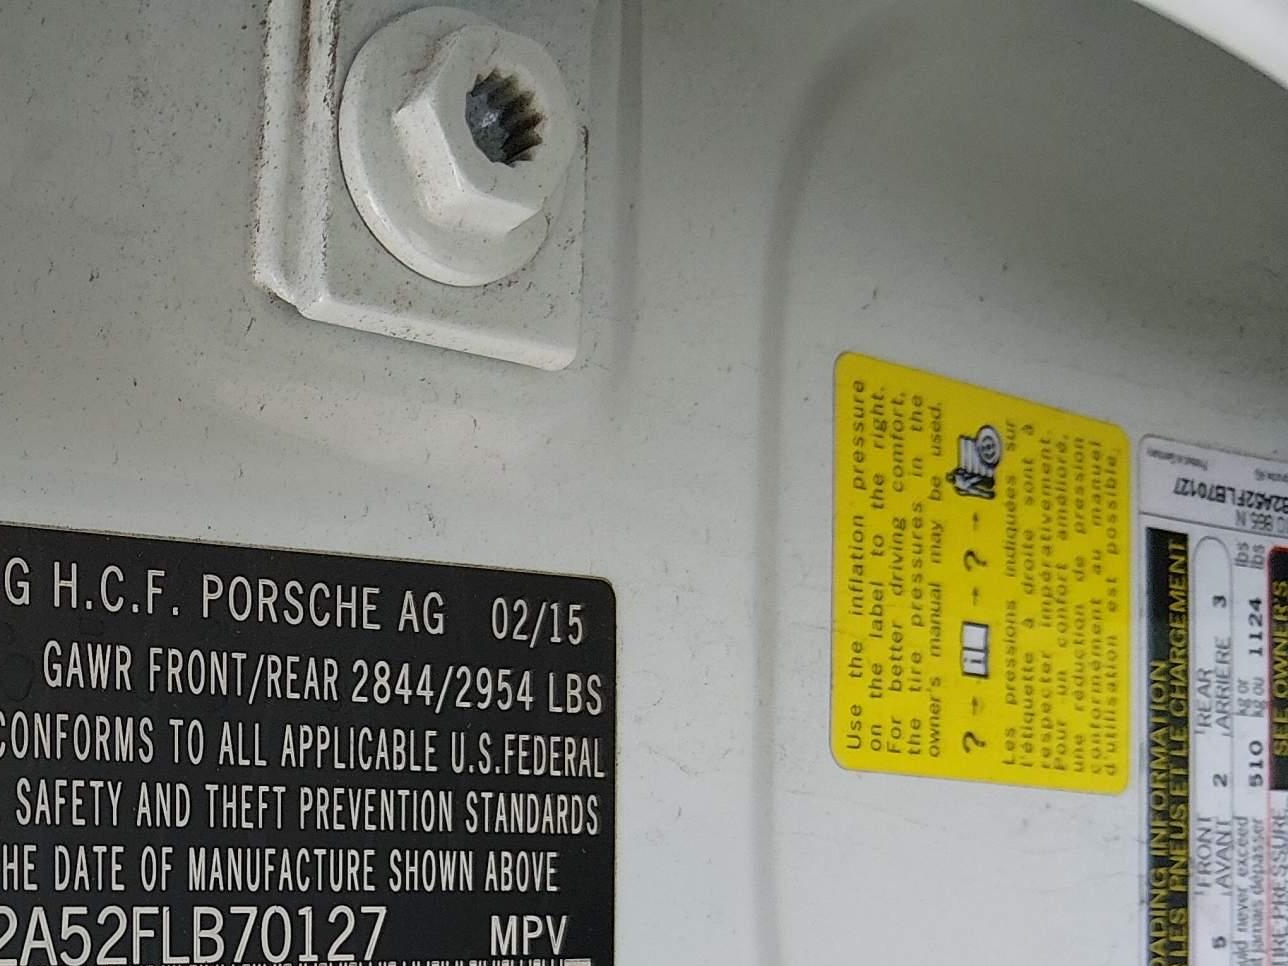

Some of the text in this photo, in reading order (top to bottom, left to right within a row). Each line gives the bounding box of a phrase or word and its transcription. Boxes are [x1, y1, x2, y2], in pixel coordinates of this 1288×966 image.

[870, 473, 884, 509] the
[928, 476, 941, 501] be
[846, 380, 866, 750] Use the inflation pressure
[871, 535, 884, 556] to
[889, 517, 906, 596] driving
[929, 520, 944, 563] may
[907, 395, 924, 755] the tire pressures in the
[53, 561, 181, 617] H.C.F.
[202, 574, 381, 630] PORSCHE
[399, 591, 445, 635] AG
[491, 597, 583, 648] 02/15
[869, 581, 883, 638] label
[928, 582, 942, 657] manual
[1249, 597, 1263, 656] 1124
[43, 640, 602, 715] GAWR FRONT/REAR 2844/2954 LBS
[868, 663, 883, 698] the
[888, 621, 903, 692] better
[870, 724, 882, 751] on
[886, 716, 902, 754] For
[926, 677, 941, 757] owner's
[170, 719, 204, 765] TO
[219, 721, 267, 766] ALL
[281, 724, 437, 773] APPLICABLE
[451, 732, 606, 778] U.S.FEDERAL
[1149, 659, 1167, 856] INFORMATION
[1249, 741, 1264, 788] 510
[16, 776, 122, 826] SAFETY
[136, 782, 191, 828] AND
[205, 783, 286, 830] THEFT
[299, 787, 454, 833] PREVENTION
[465, 790, 599, 836] STANDARDS
[1213, 773, 1228, 788] 2
[54, 844, 124, 892] DATE
[140, 846, 173, 892] OF
[188, 846, 377, 893] MANUFACTURE
[388, 848, 473, 893] SHOWN
[485, 849, 559, 893] ABOVE
[490, 914, 568, 957] MPV
